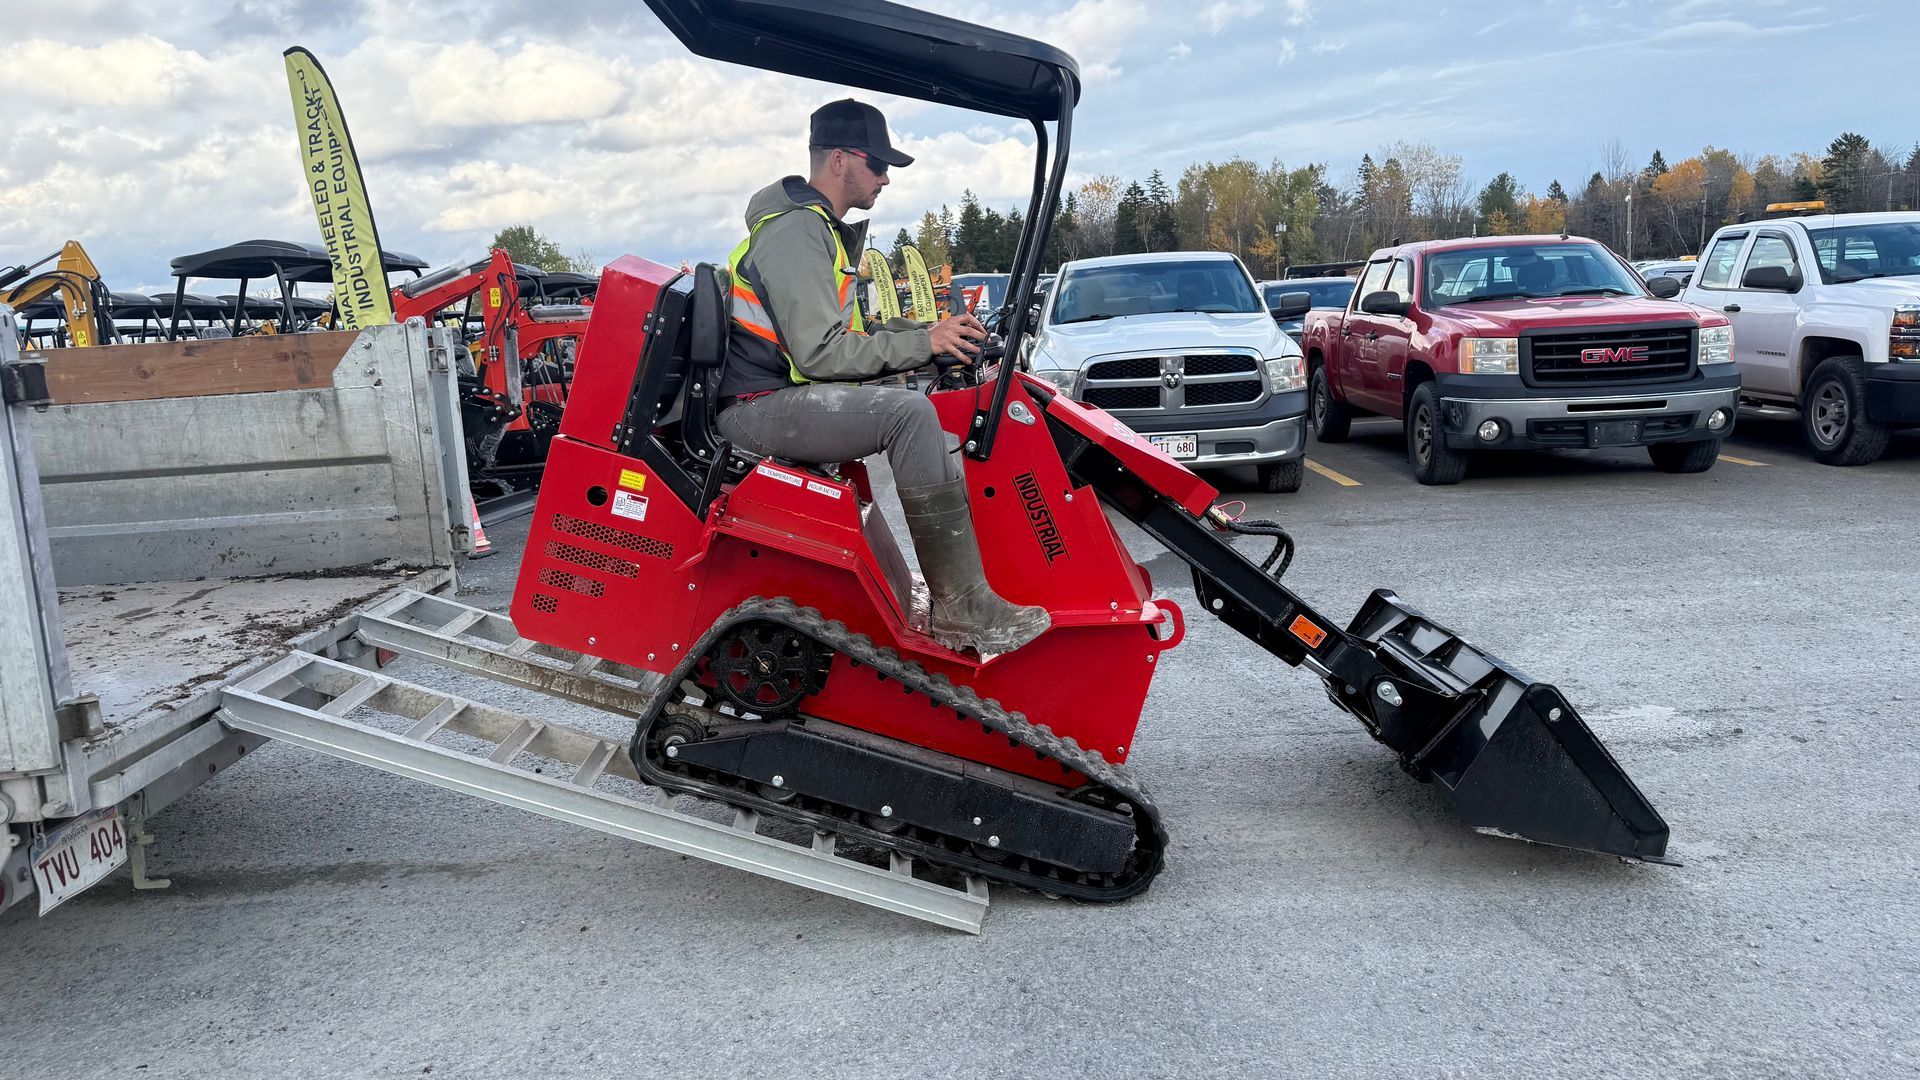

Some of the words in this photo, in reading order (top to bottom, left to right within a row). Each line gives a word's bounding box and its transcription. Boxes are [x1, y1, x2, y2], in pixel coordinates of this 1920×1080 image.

[311, 160, 325, 174] &
[314, 179, 343, 271] WHEELED
[337, 197, 374, 310] INDUSTRIAL
[1580, 345, 1649, 364] GMC
[1176, 442, 1195, 453] 680
[767, 469, 802, 486] TEMPERATURE
[808, 482, 823, 491] HOUR
[823, 487, 840, 497] METER
[1014, 471, 1066, 562] INDUSTRIAL
[38, 846, 80, 895] TVU
[90, 819, 123, 864] 404
